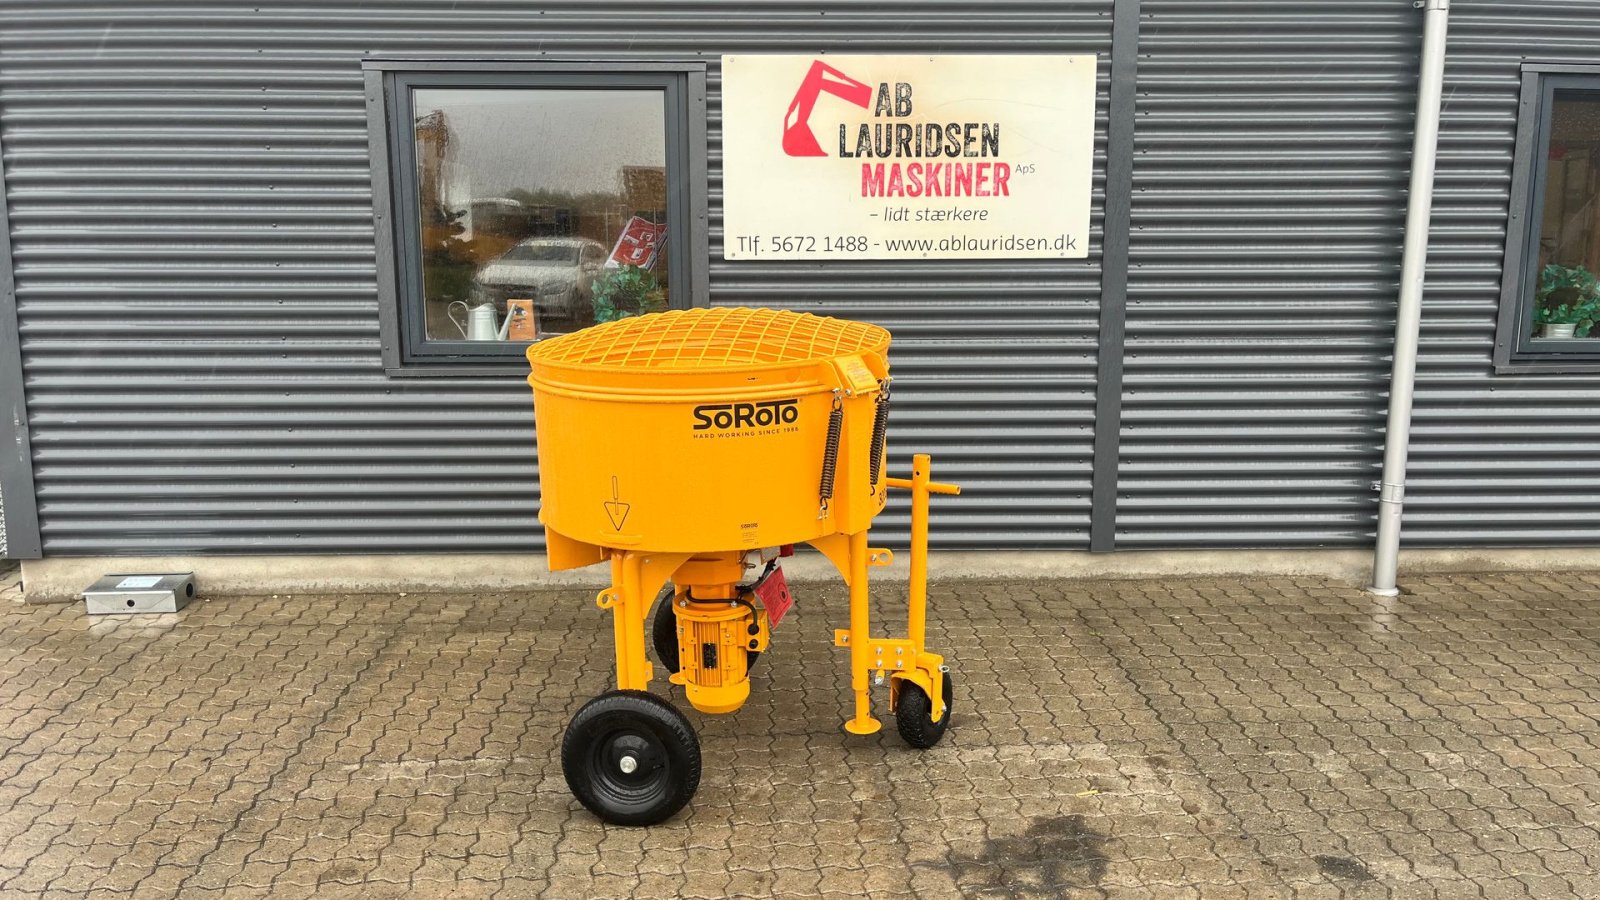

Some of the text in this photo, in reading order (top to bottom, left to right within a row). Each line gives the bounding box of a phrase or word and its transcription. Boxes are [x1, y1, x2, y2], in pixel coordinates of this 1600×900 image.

[874, 82, 913, 117] AB
[839, 123, 1000, 158] LAURIDSEN
[861, 162, 1036, 197] MASKINER ApS
[884, 206, 910, 222] lidt
[915, 206, 989, 221] stærkere
[736, 235, 765, 257] Tlf.
[771, 236, 816, 252] 5672
[823, 235, 868, 252] 1488
[885, 234, 1077, 252] www.ablauridsen.dk
